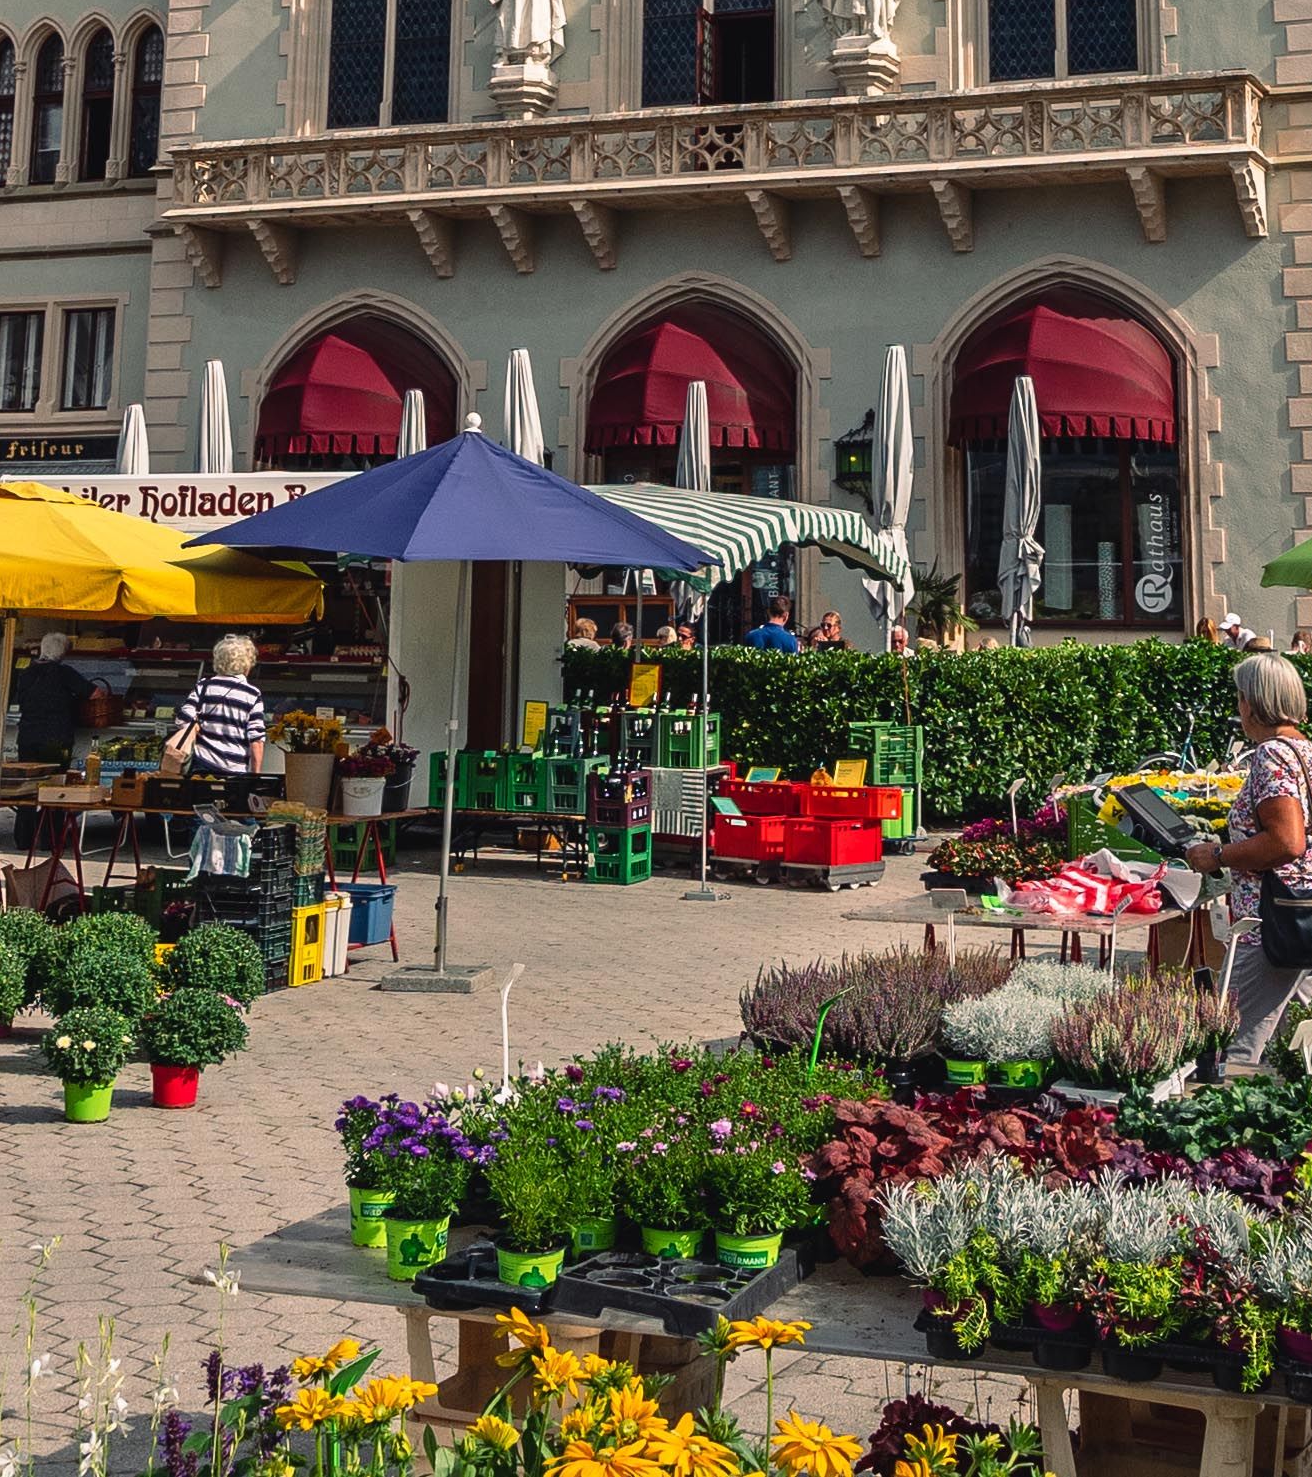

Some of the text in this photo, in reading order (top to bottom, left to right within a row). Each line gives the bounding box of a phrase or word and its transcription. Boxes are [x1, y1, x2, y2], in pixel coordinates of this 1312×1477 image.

[6, 441, 85, 459] Friseur
[139, 485, 274, 523] Hofladen
[1136, 493, 1174, 612] Rathaus
